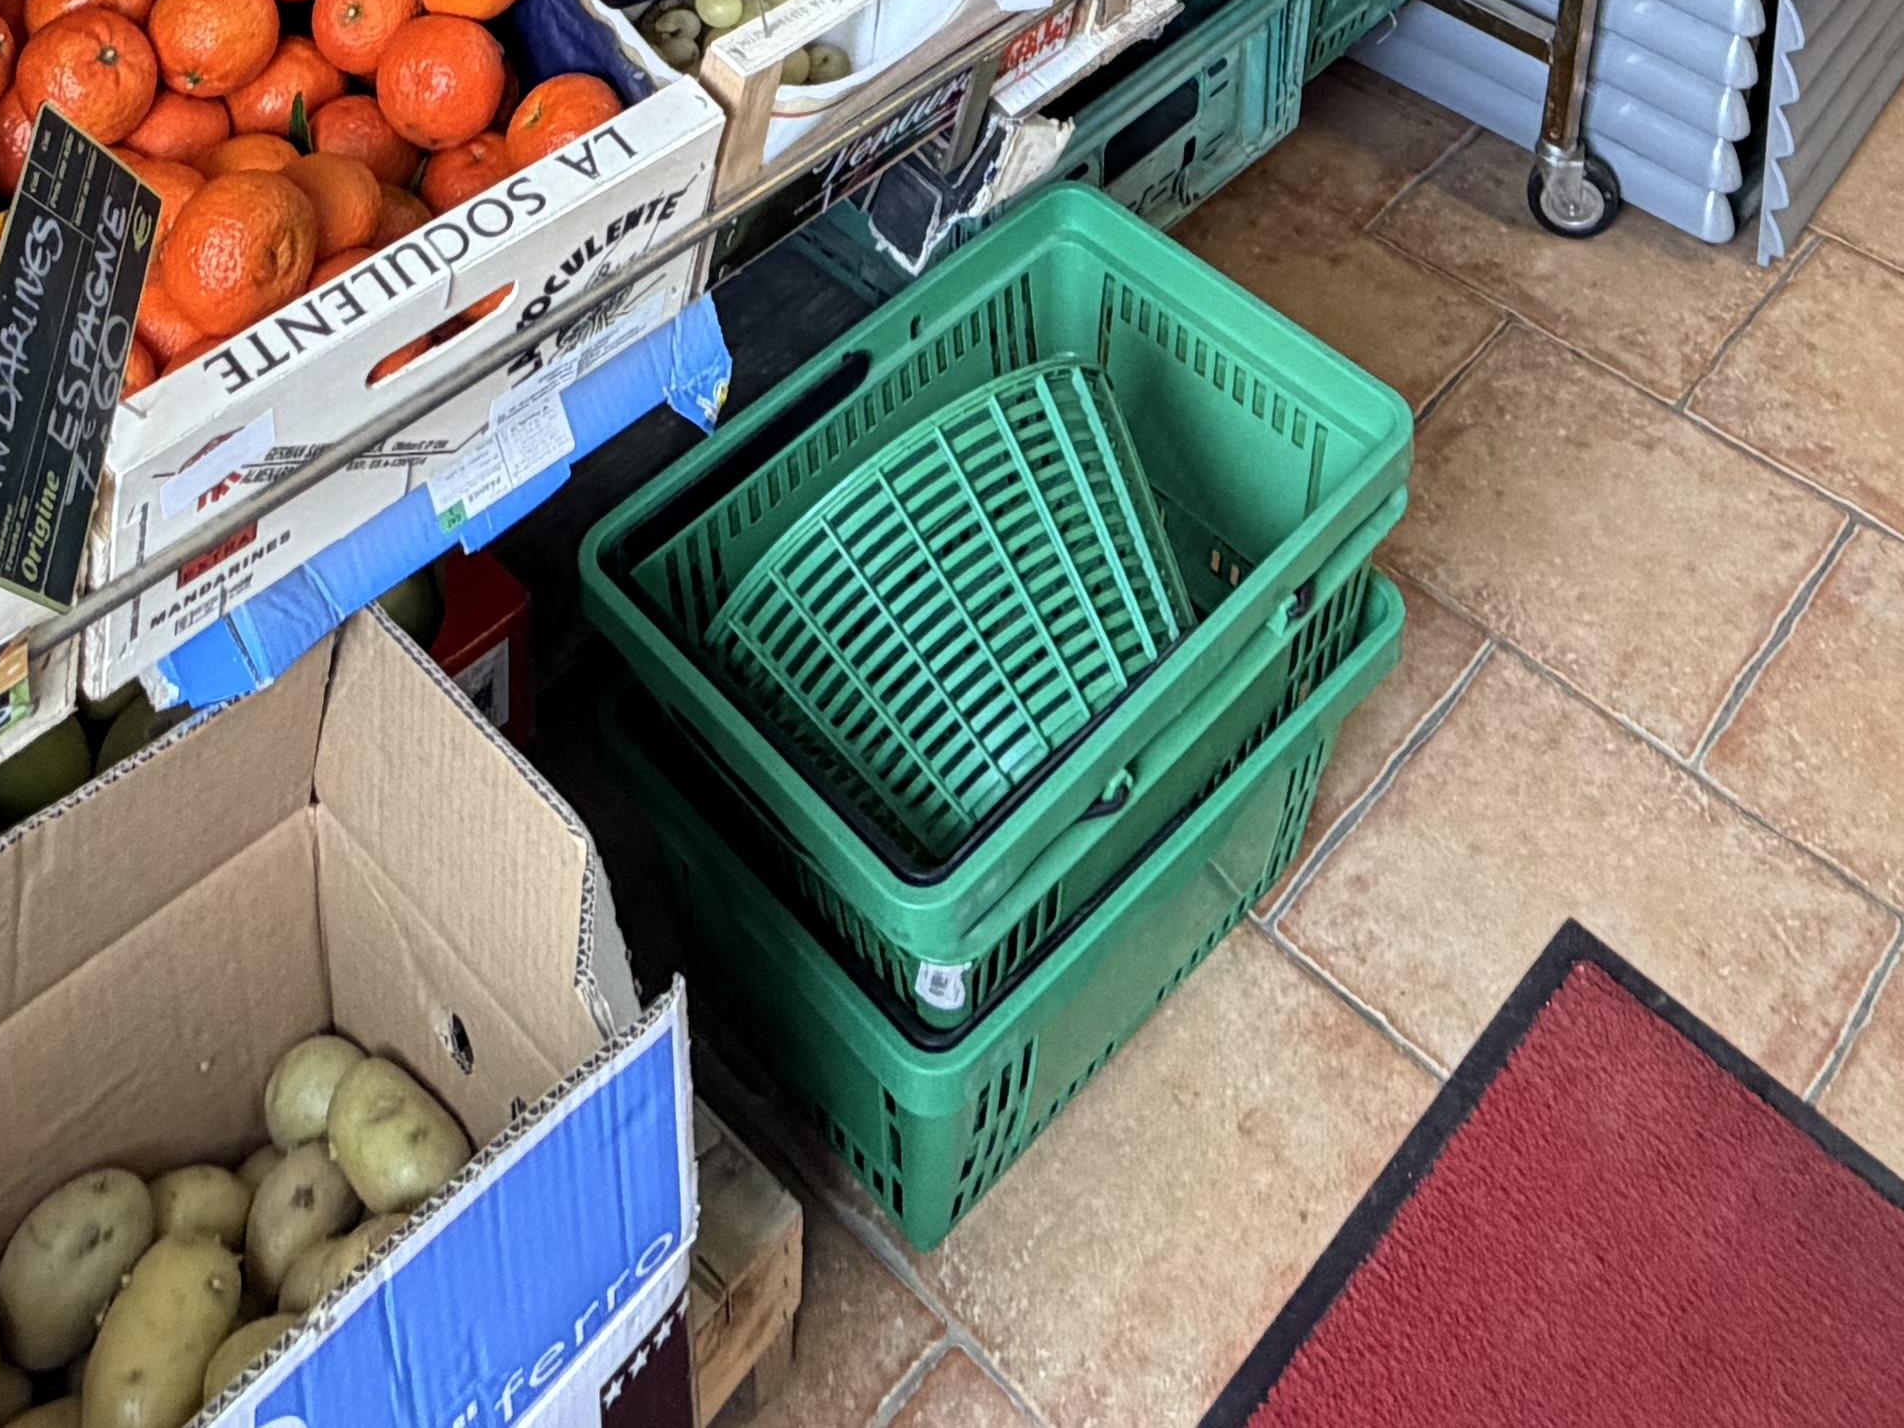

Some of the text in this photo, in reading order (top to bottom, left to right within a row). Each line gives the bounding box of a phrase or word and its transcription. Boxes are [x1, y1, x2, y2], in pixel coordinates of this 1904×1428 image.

[560, 126, 640, 179] LA
[132, 206, 152, 253] €
[202, 187, 550, 396] SOCULENTE
[21, 470, 62, 583] Origine
[48, 194, 127, 451] ESPAGNE
[151, 530, 291, 630] MANDARINES
